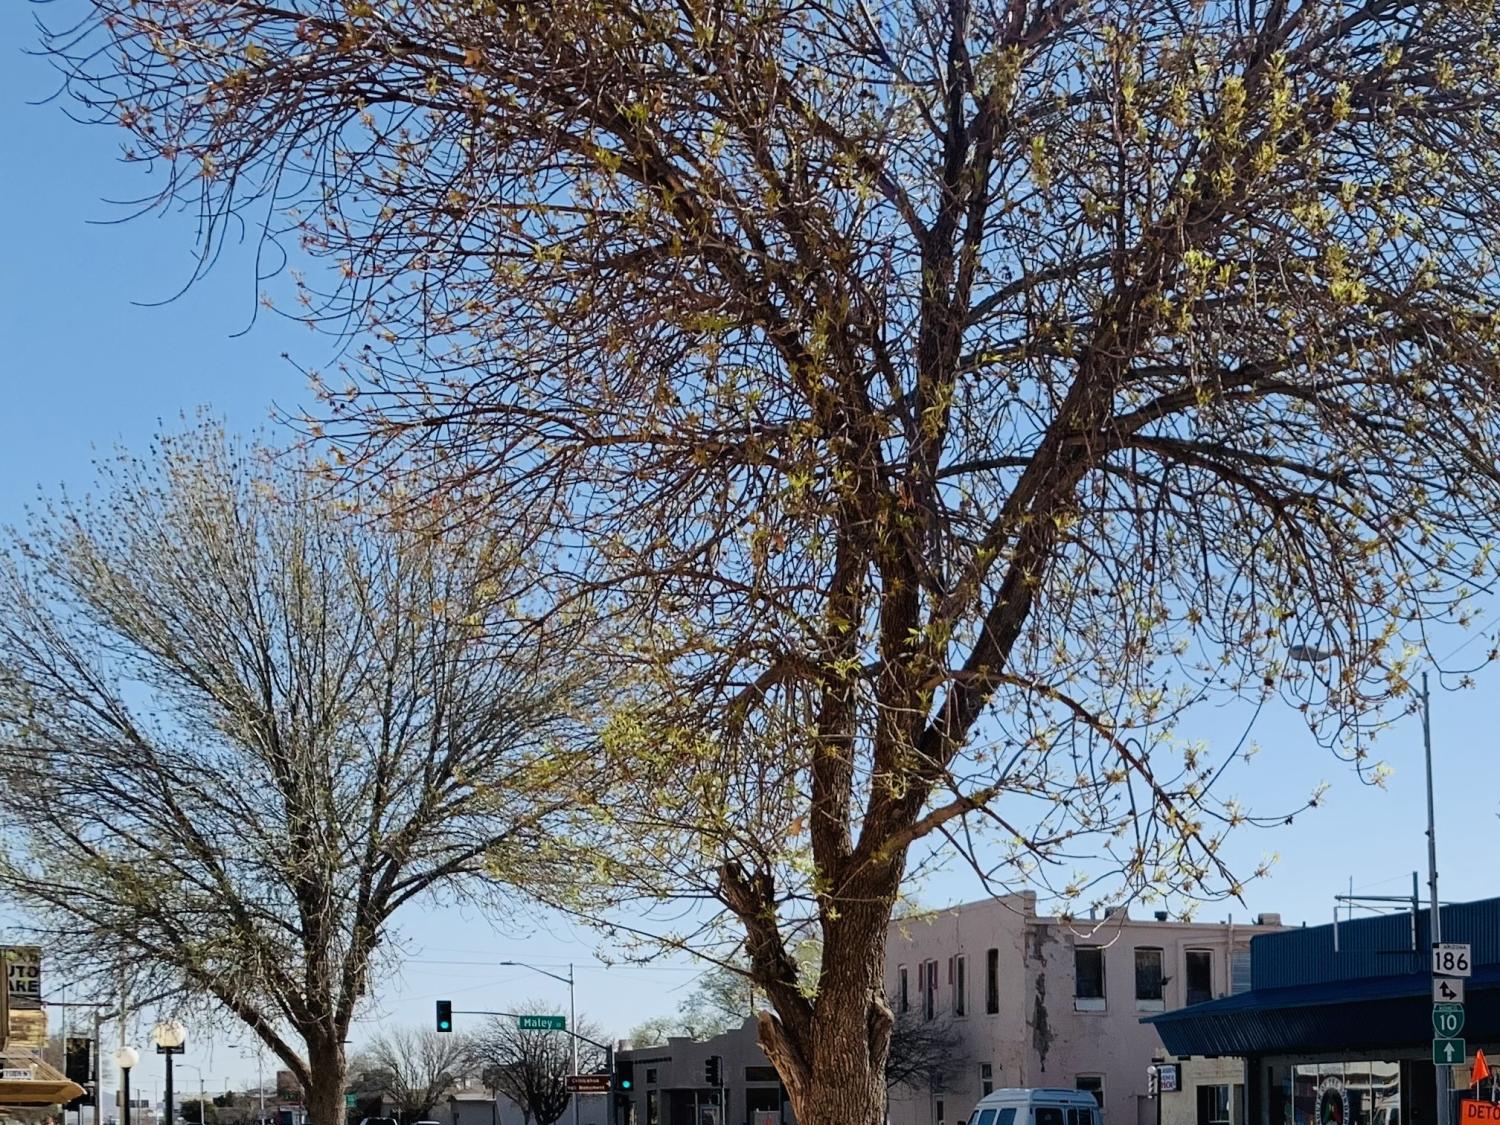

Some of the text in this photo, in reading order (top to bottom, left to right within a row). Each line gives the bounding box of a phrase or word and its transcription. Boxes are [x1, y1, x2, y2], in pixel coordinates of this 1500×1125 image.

[1435, 952, 1468, 970] 186
[524, 1018, 552, 1029] Maley
[1440, 1014, 1457, 1031] 10
